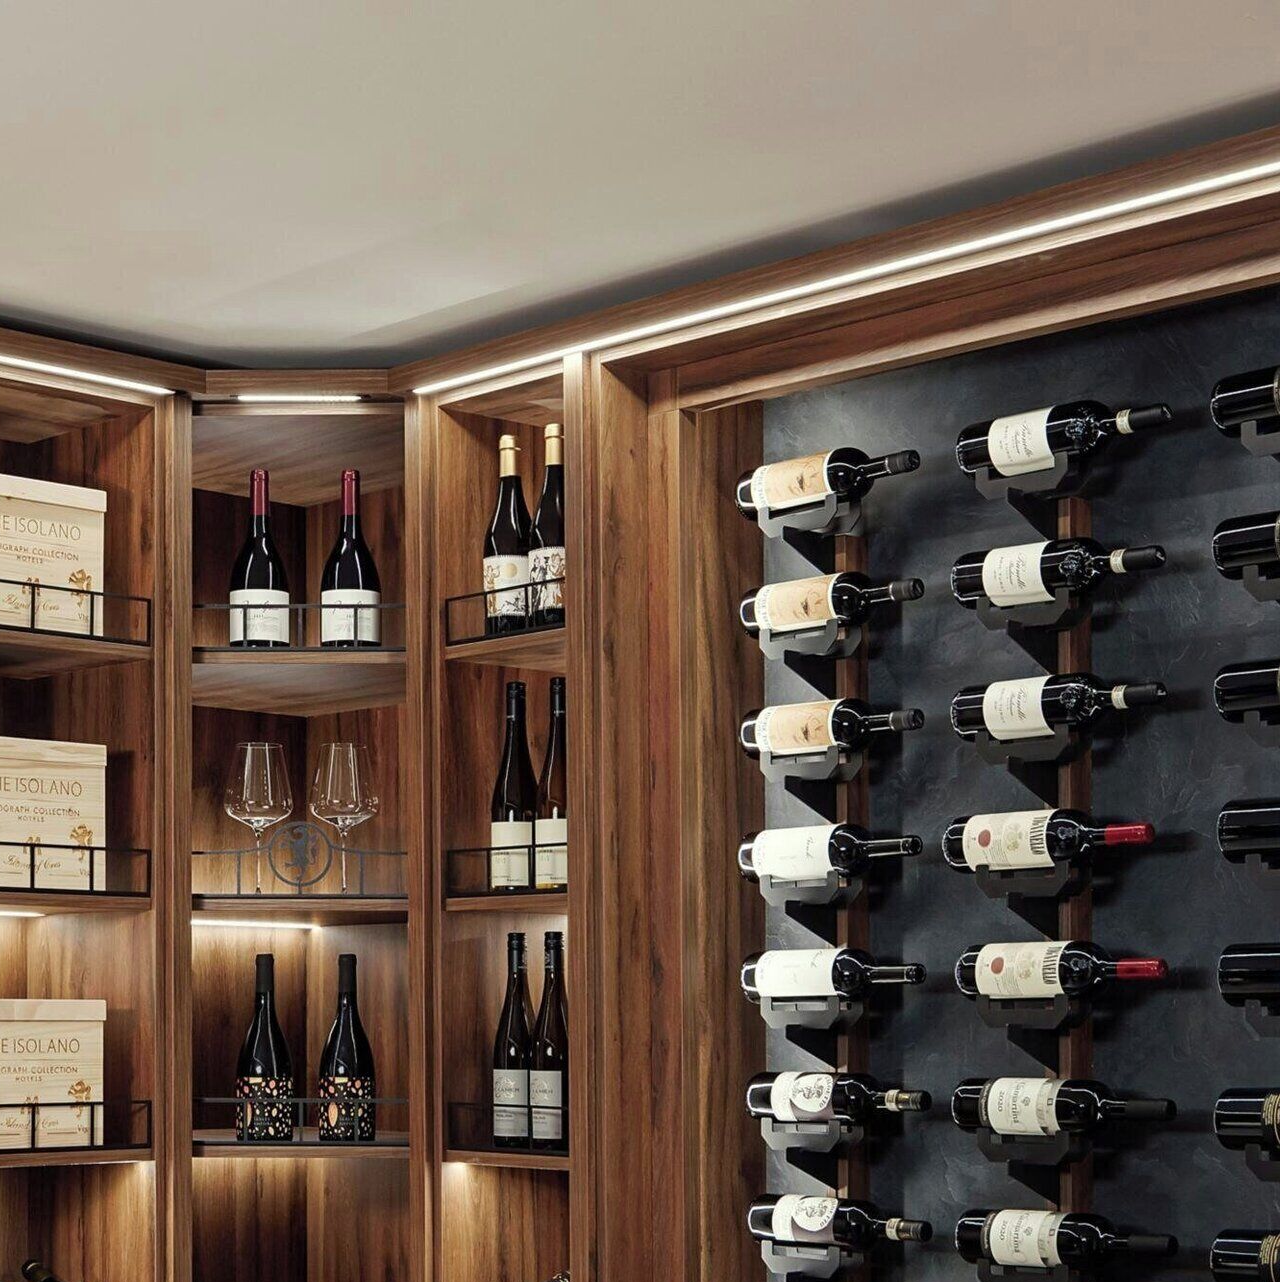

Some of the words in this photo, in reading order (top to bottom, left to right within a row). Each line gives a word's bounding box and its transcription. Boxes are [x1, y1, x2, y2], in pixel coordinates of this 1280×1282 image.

[14, 517, 81, 541] ISOLANO
[32, 547, 80, 561] COLLECTION
[15, 778, 82, 798] ISOLANO
[33, 807, 80, 817] COLLECTION
[13, 1038, 80, 1054] ISOLANO
[31, 1066, 78, 1074] COLLECTION
[999, 1220, 1008, 1241] 2020
